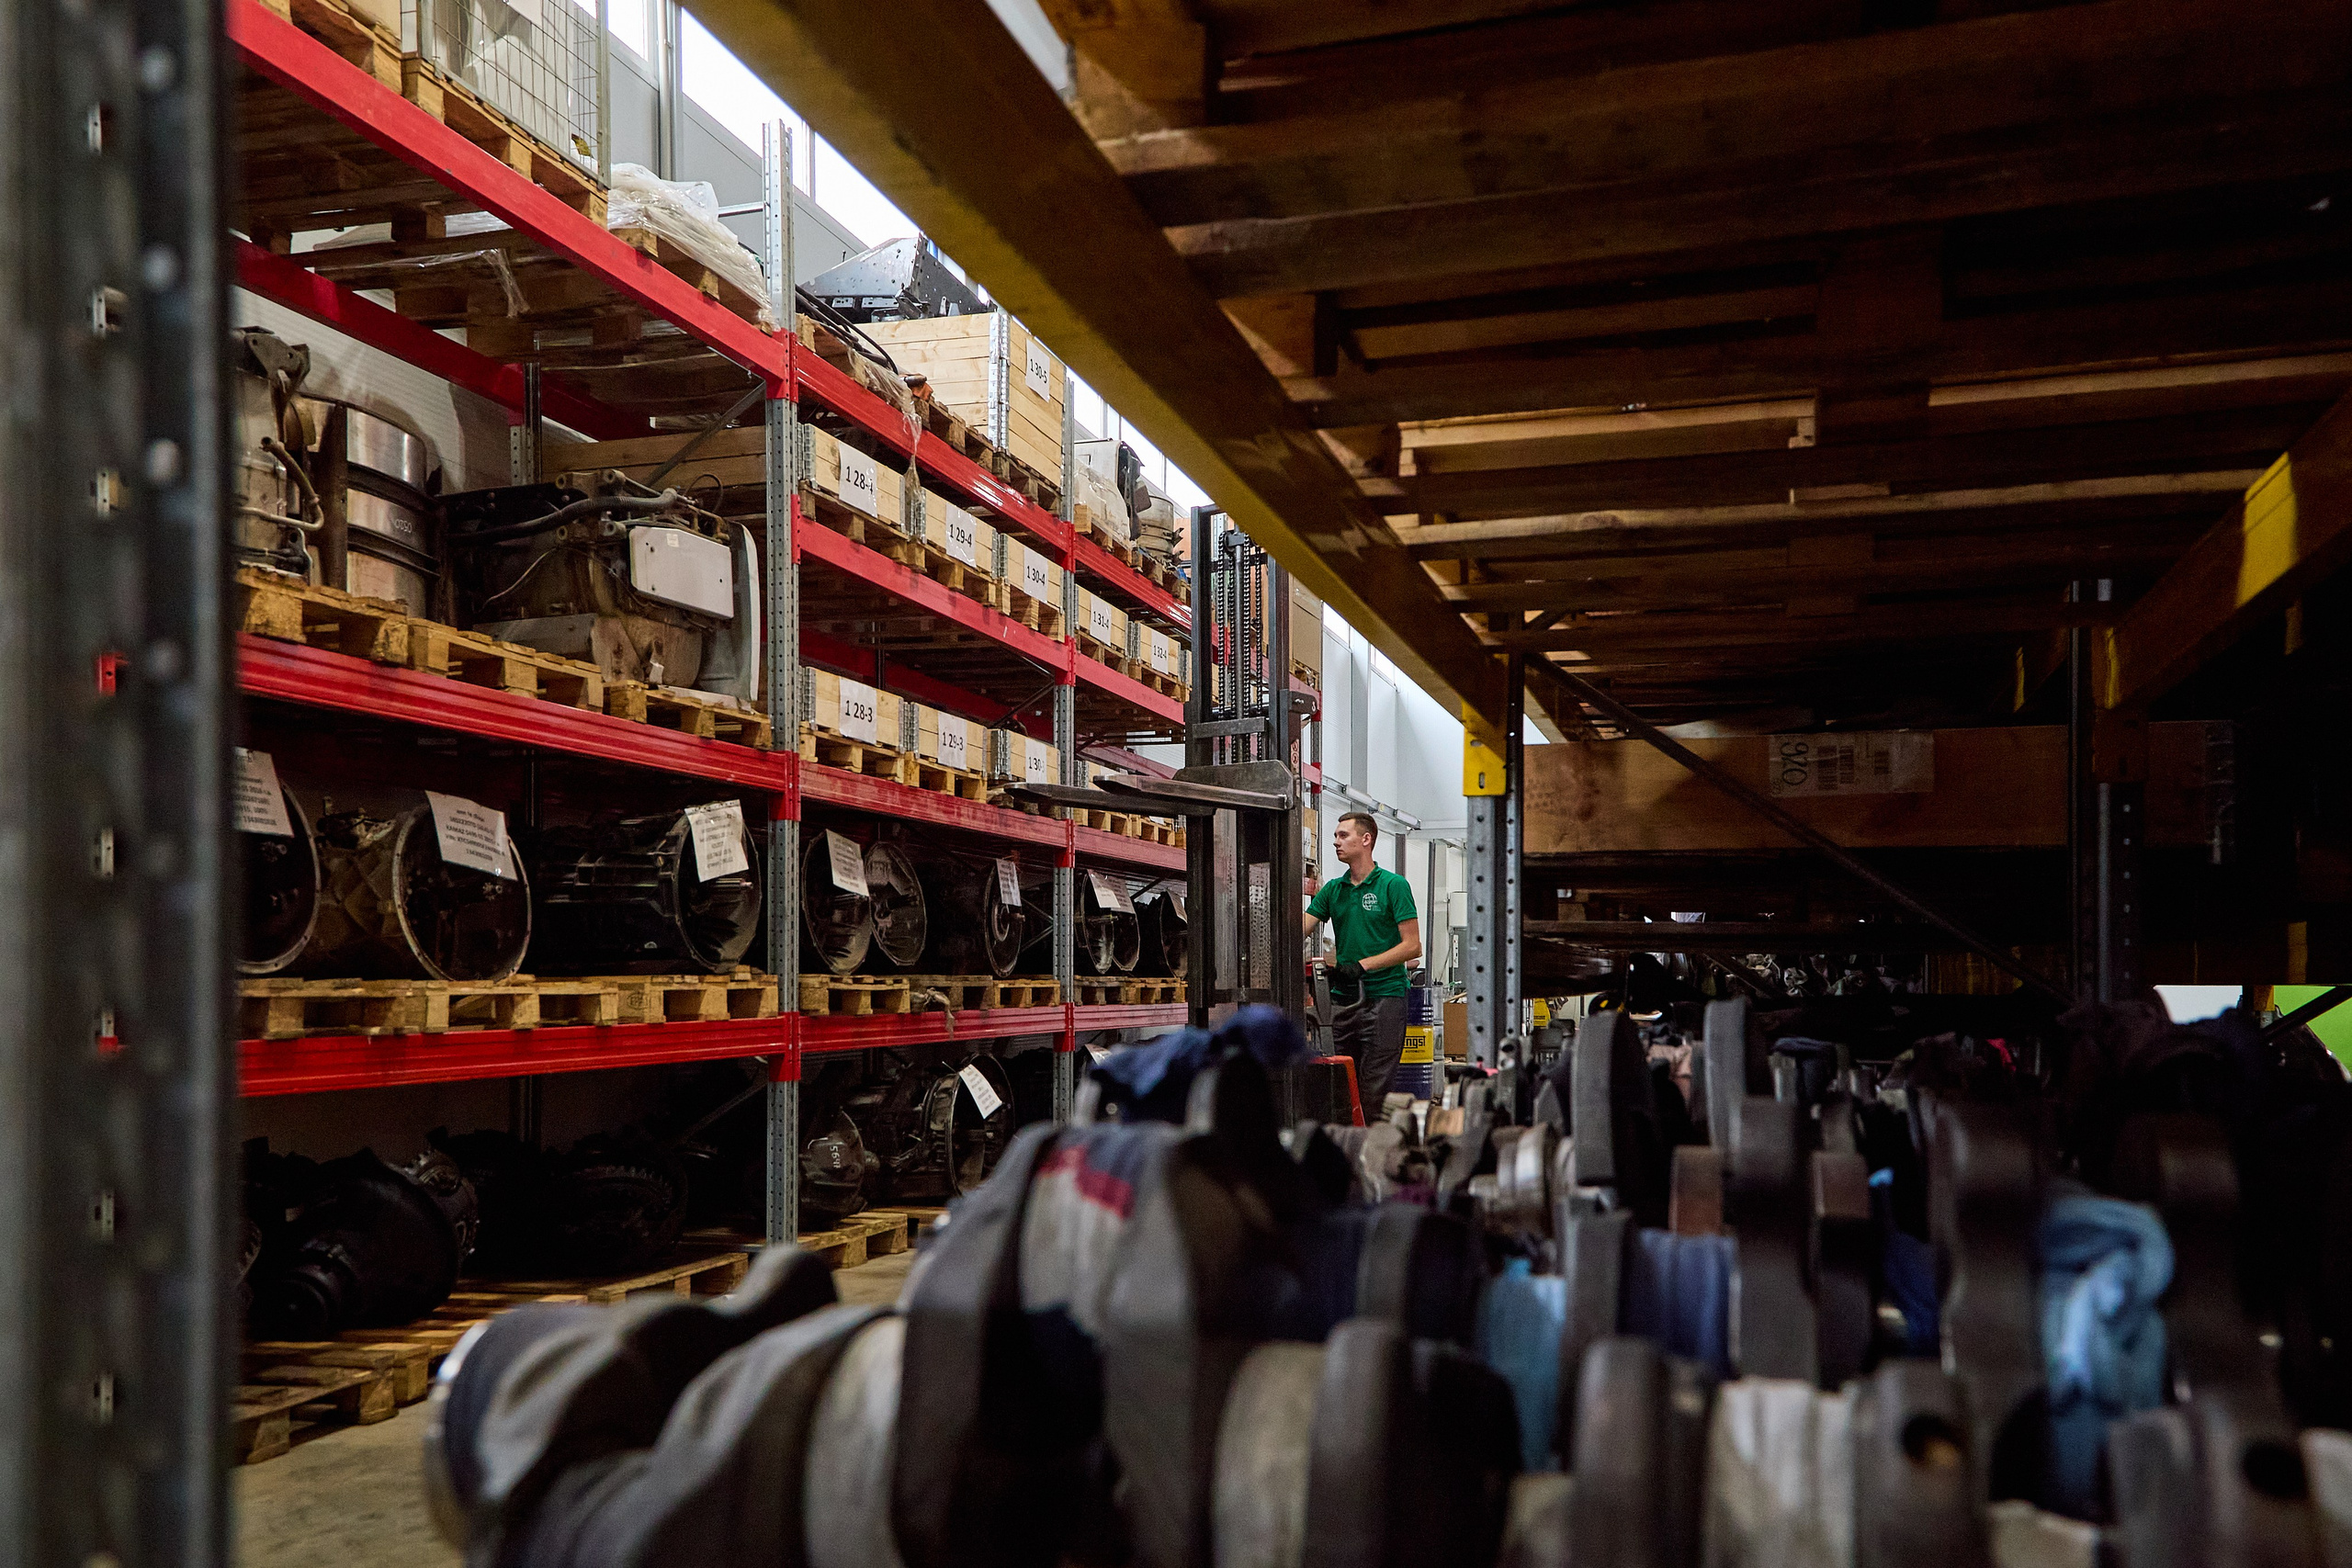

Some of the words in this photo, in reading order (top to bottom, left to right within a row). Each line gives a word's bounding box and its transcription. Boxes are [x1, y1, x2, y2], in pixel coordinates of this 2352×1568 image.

[1035, 362, 1047, 384] 30-5
[845, 466, 851, 483] 1
[950, 524, 955, 539] 1
[956, 526, 972, 547] 29-4
[1032, 568, 1046, 586] 30-4
[845, 700, 851, 716] 1
[854, 702, 873, 723] 28-3
[943, 731, 947, 747] 1
[948, 733, 964, 751] 29-3
[1403, 1035, 1426, 1049] ngst
